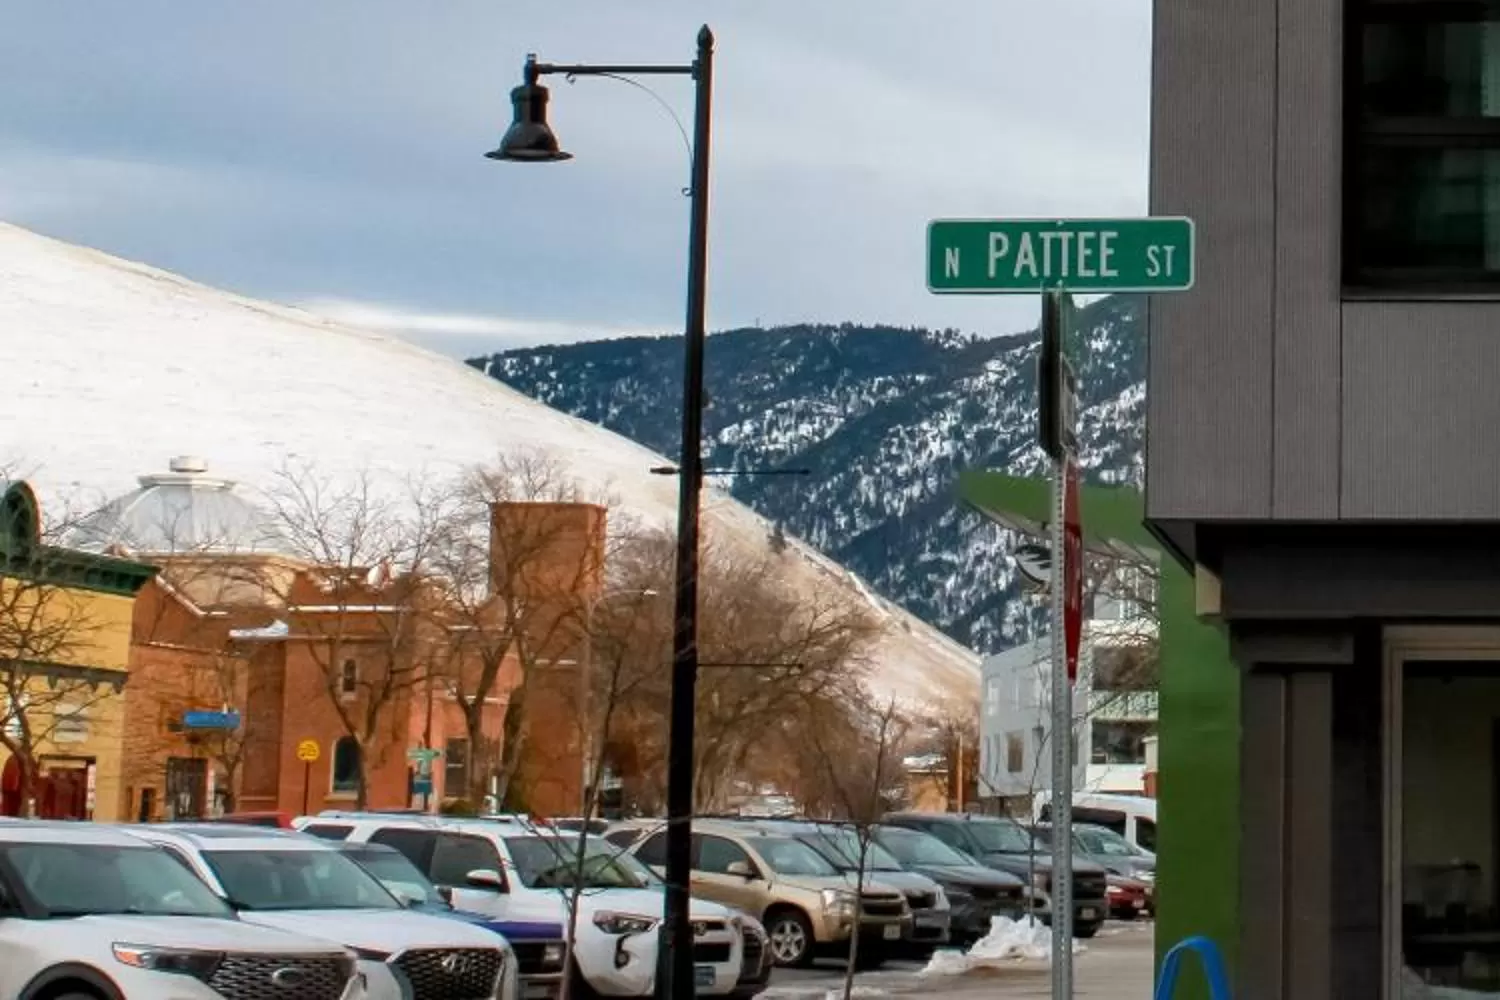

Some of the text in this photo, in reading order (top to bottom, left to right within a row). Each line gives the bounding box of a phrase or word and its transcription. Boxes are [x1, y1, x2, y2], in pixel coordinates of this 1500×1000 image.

[945, 231, 1176, 278] N PATTEE ST
